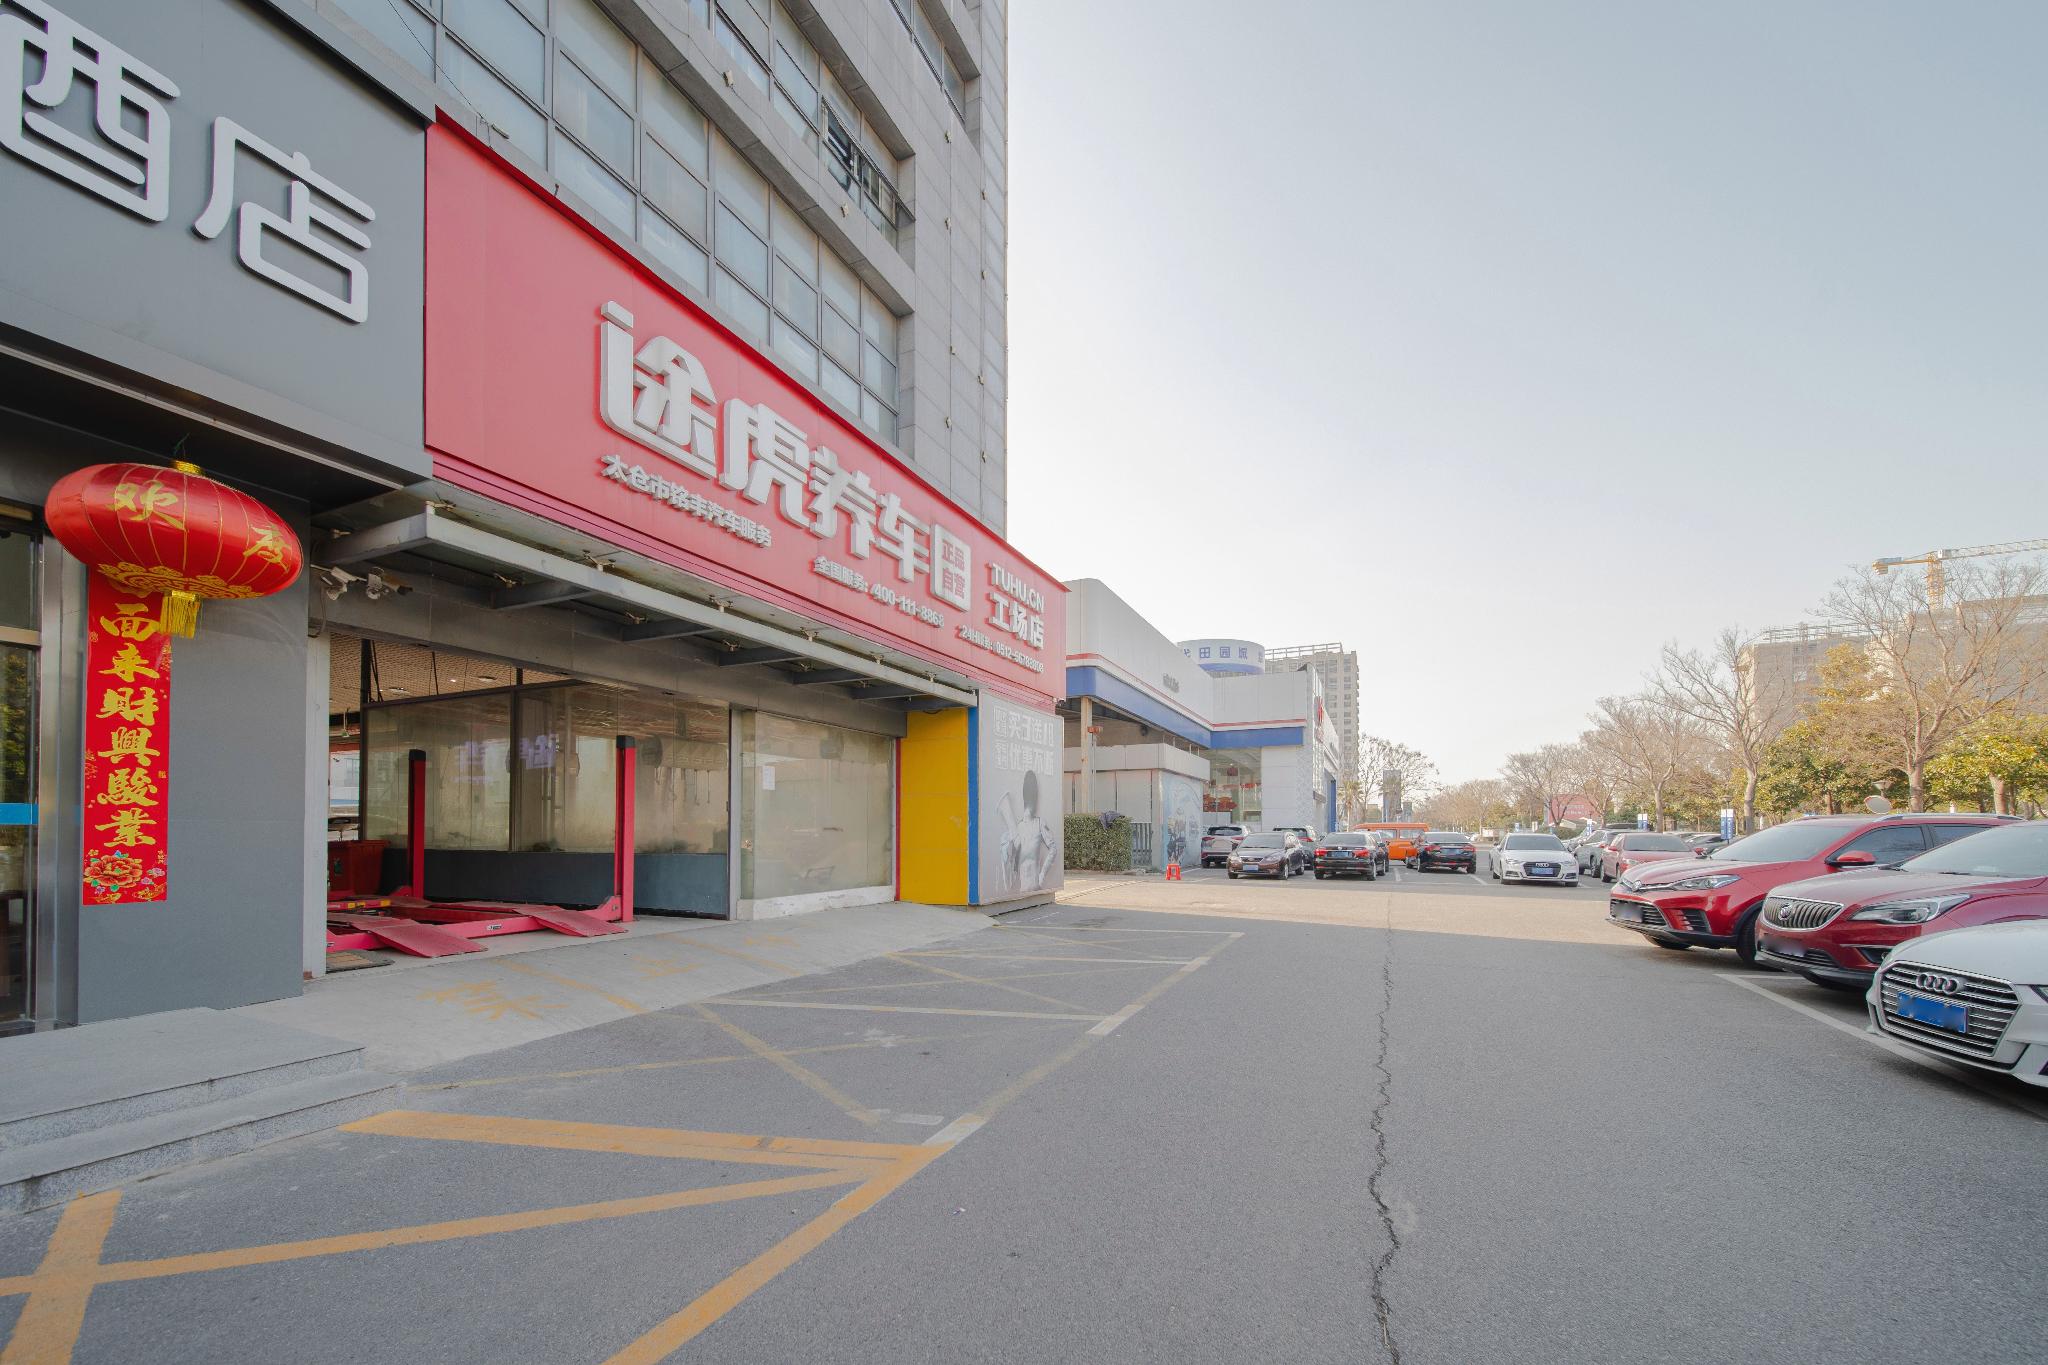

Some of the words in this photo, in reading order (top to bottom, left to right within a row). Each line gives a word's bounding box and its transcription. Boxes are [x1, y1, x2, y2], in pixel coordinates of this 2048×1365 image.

[600, 300, 930, 584] 途虎养车
[942, 539, 965, 572] 正品
[990, 562, 1045, 614] TUHU.CN
[989, 591, 1045, 651] 工场店
